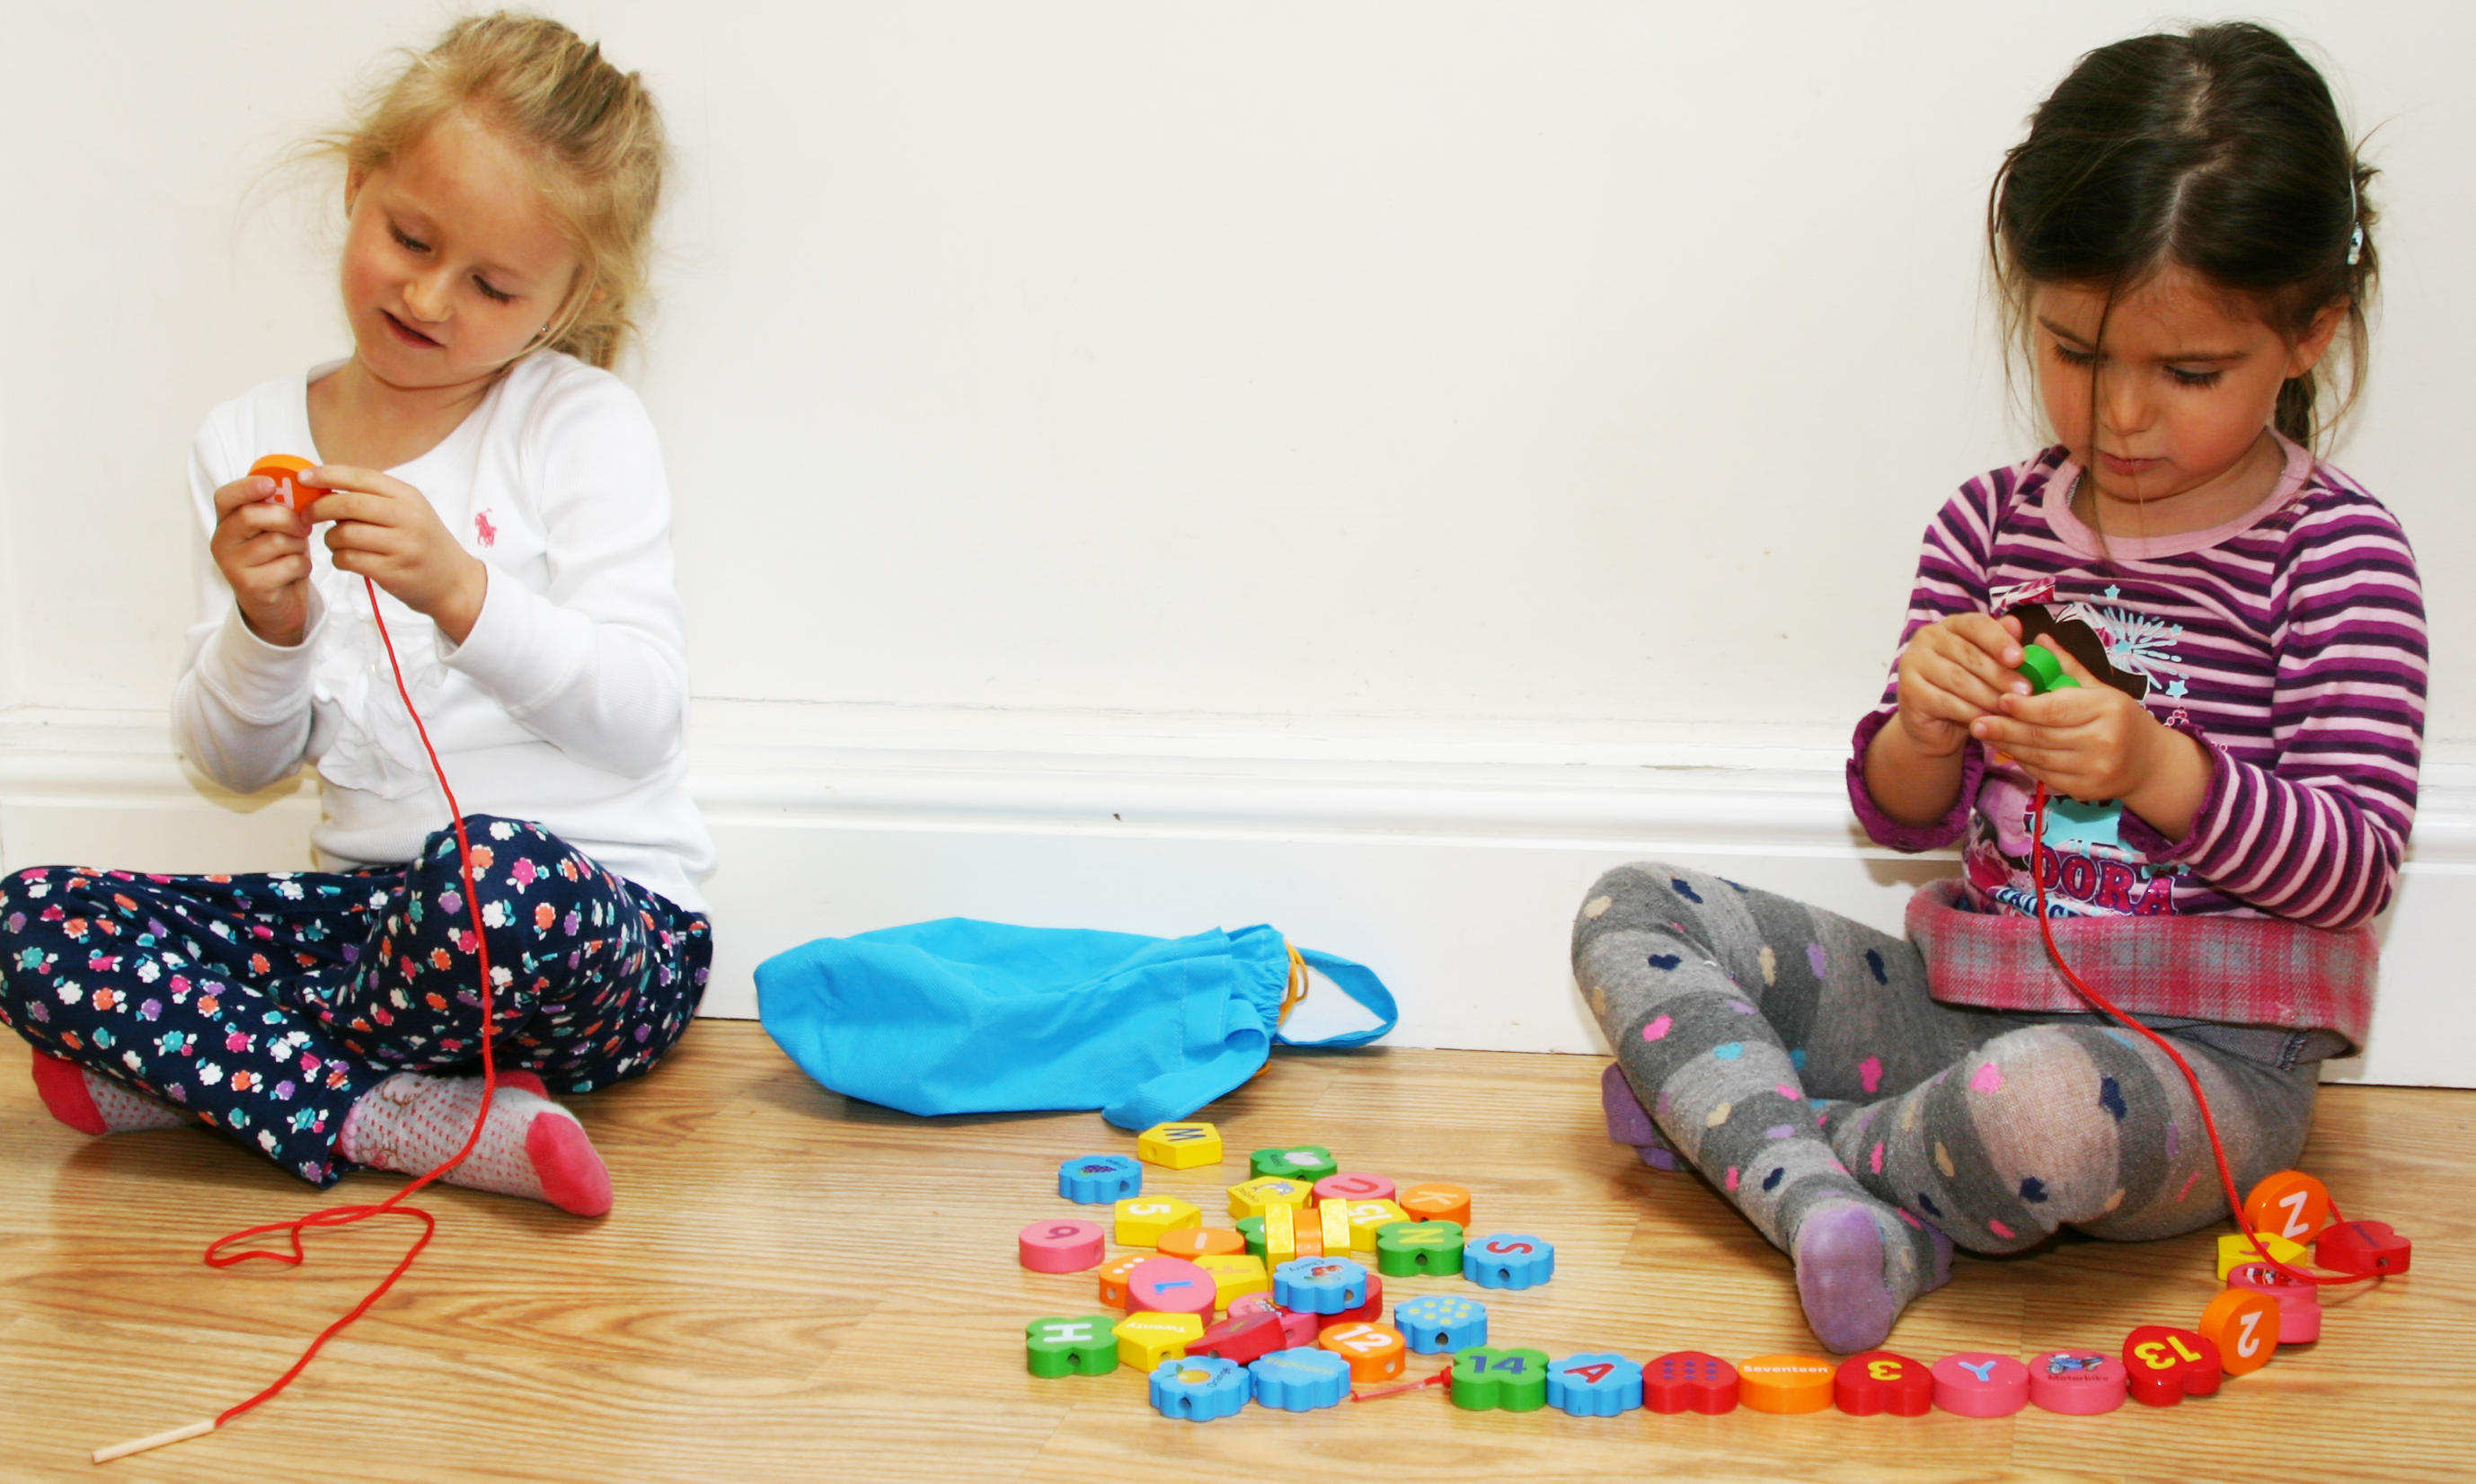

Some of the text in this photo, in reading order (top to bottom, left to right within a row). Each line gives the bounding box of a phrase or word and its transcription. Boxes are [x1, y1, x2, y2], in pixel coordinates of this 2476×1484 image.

[2029, 841, 2178, 916] DORA
[1331, 1178, 1379, 1194] U
[1410, 1191, 1458, 1206] K
[1127, 1204, 1171, 1215] 5
[1486, 1241, 1533, 1254] S
[1042, 1322, 1092, 1343] H
[1126, 1321, 1187, 1333] Twenty
[2237, 1311, 2262, 1358] 2
[1332, 1324, 1393, 1353] 12
[2134, 1335, 2203, 1370] 13
[1468, 1356, 1526, 1374] 14
[1563, 1363, 1614, 1384] A
[1743, 1365, 1828, 1374] Seventeen
[1867, 1360, 1903, 1382] 3
[1958, 1360, 1997, 1382] Y
